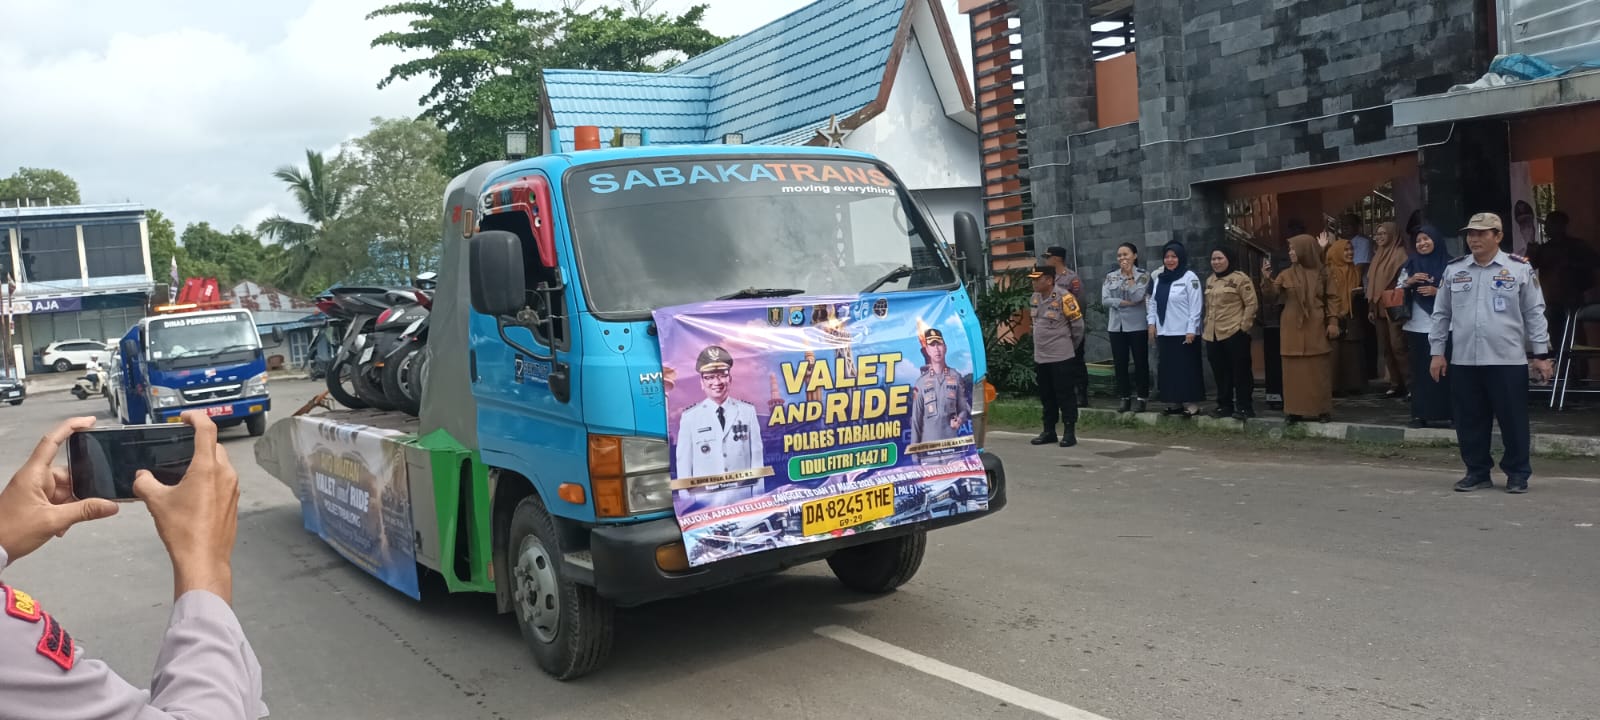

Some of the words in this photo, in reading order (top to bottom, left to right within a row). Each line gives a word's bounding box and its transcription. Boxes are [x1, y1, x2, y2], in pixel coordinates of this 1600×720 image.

[782, 184, 831, 194] moving
[833, 185, 896, 196] everything
[35, 300, 59, 312] AJA
[781, 352, 902, 394] VALET
[768, 402, 822, 427] AND
[825, 385, 910, 424] RIDE
[784, 429, 835, 453] POLRES
[837, 420, 901, 445] TABALONG
[801, 460, 827, 475] IDUL
[828, 453, 853, 470] FITRI
[855, 449, 879, 466] 1447
[880, 448, 888, 462] H
[349, 485, 370, 513] RIDE
[772, 489, 803, 502] TANGGAL
[812, 485, 828, 498] DAN
[829, 485, 837, 494] 17
[898, 485, 910, 496] PAL
[679, 513, 712, 527] MUDIK
[712, 506, 740, 520] AMAN
[806, 503, 825, 525] DA
[827, 494, 864, 519] 8245
[866, 487, 891, 510] THE
